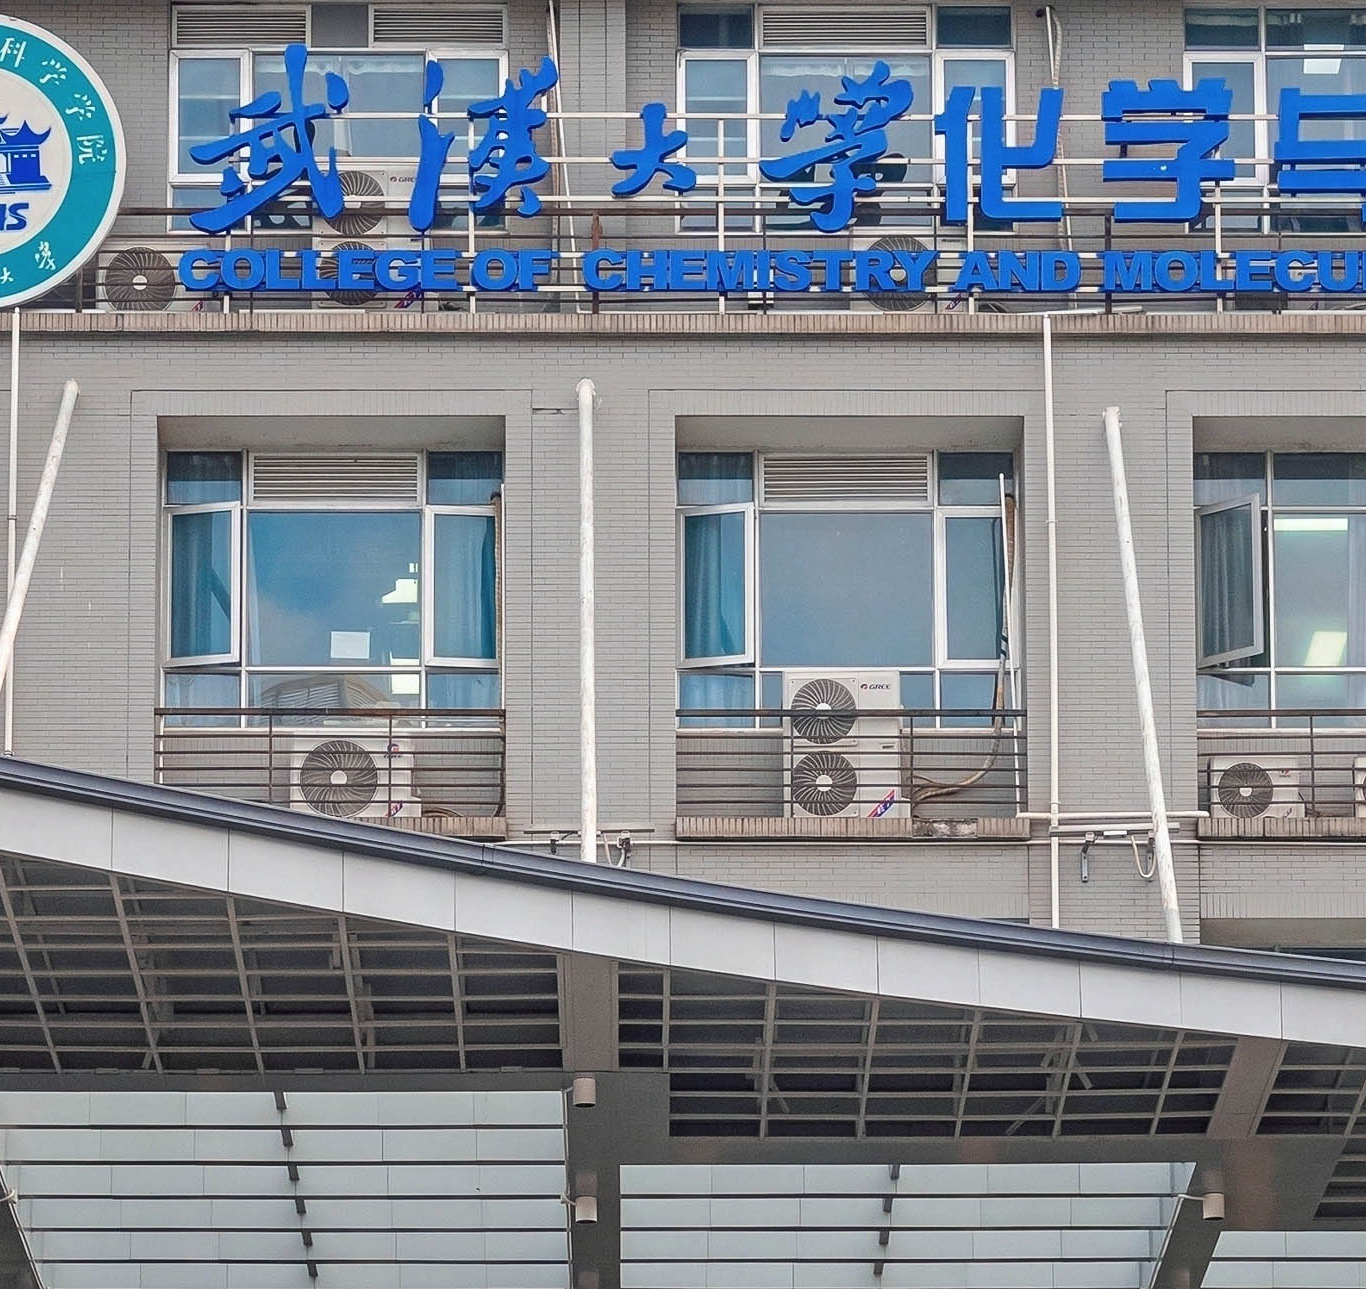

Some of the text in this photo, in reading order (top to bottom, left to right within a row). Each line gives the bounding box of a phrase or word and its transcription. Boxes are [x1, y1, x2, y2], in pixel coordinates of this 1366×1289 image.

[178, 249, 460, 291] COLLEGE
[472, 249, 559, 290] OF
[582, 249, 937, 291] CHEMISTRY
[953, 250, 1081, 291] AND
